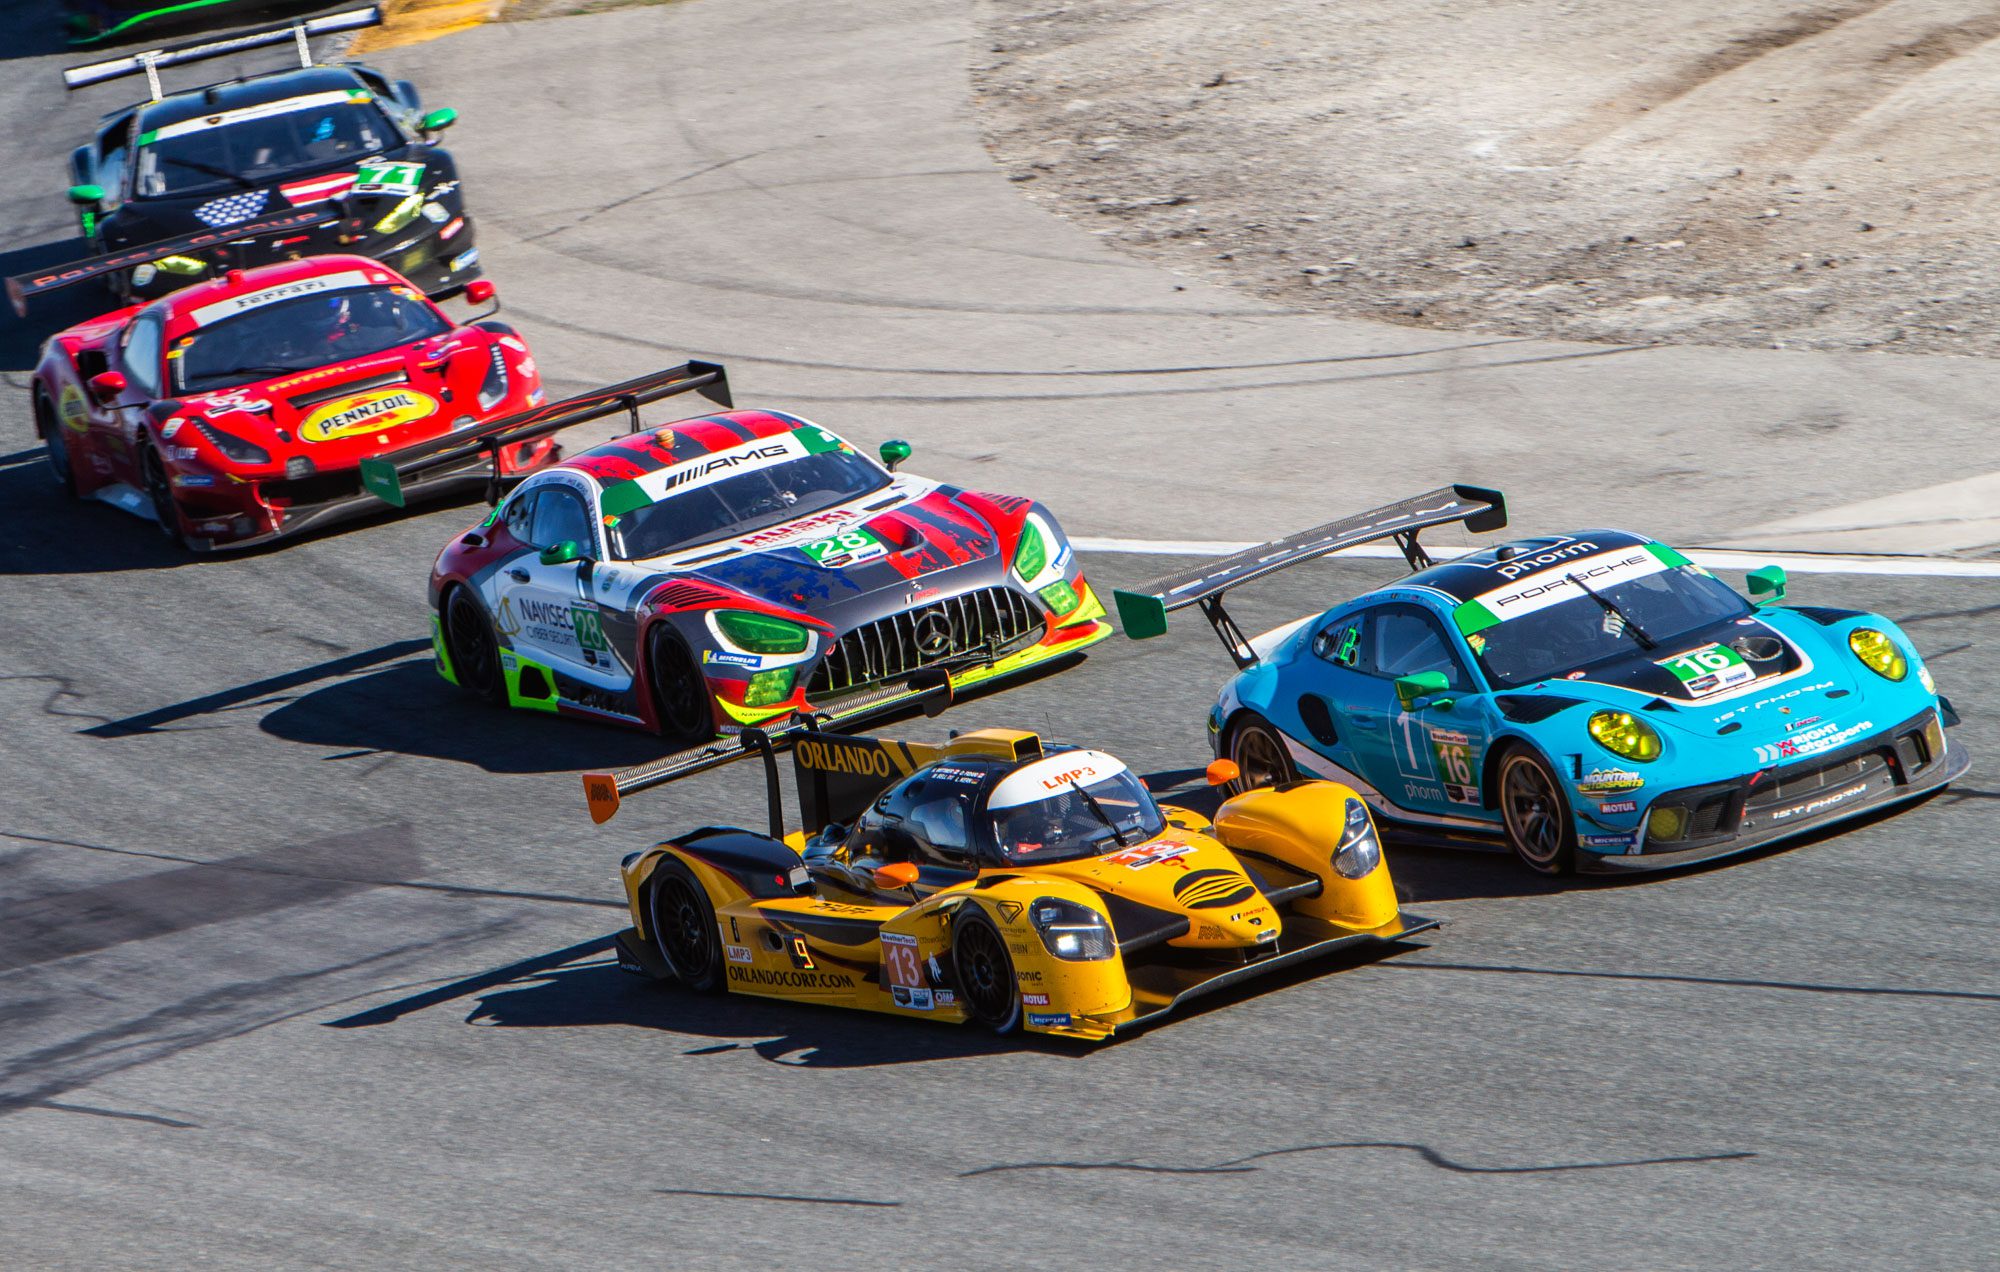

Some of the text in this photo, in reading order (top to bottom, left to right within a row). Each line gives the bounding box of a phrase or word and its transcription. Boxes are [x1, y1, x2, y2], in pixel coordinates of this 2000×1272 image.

[369, 165, 417, 186] 71
[319, 393, 417, 435] PENNZOIL
[739, 509, 853, 546] HUSKI
[811, 532, 867, 559] 28
[1497, 542, 1599, 580] phorm
[1496, 555, 1648, 606] PORSCHE
[519, 597, 575, 630] NAVISEC
[575, 610, 601, 649] 28
[718, 654, 758, 664] MICHELIN
[1675, 649, 1731, 676] 16
[1775, 722, 1838, 748] WRIGHT
[1781, 720, 1873, 758] Motorsports
[797, 740, 890, 778] ORLANDO
[1440, 744, 1470, 785] 16
[1042, 766, 1097, 790] LMP3
[1404, 781, 1444, 801] phorm
[1603, 803, 1635, 812] MOTUL
[1120, 843, 1175, 861] 13
[881, 934, 917, 945] WeatherTech
[728, 947, 751, 960] LMP3
[889, 946, 920, 987] 13
[729, 966, 856, 988] ORLANDOCORP.COM
[935, 992, 954, 1003] OMP
[1023, 995, 1048, 1005] MOTUL
